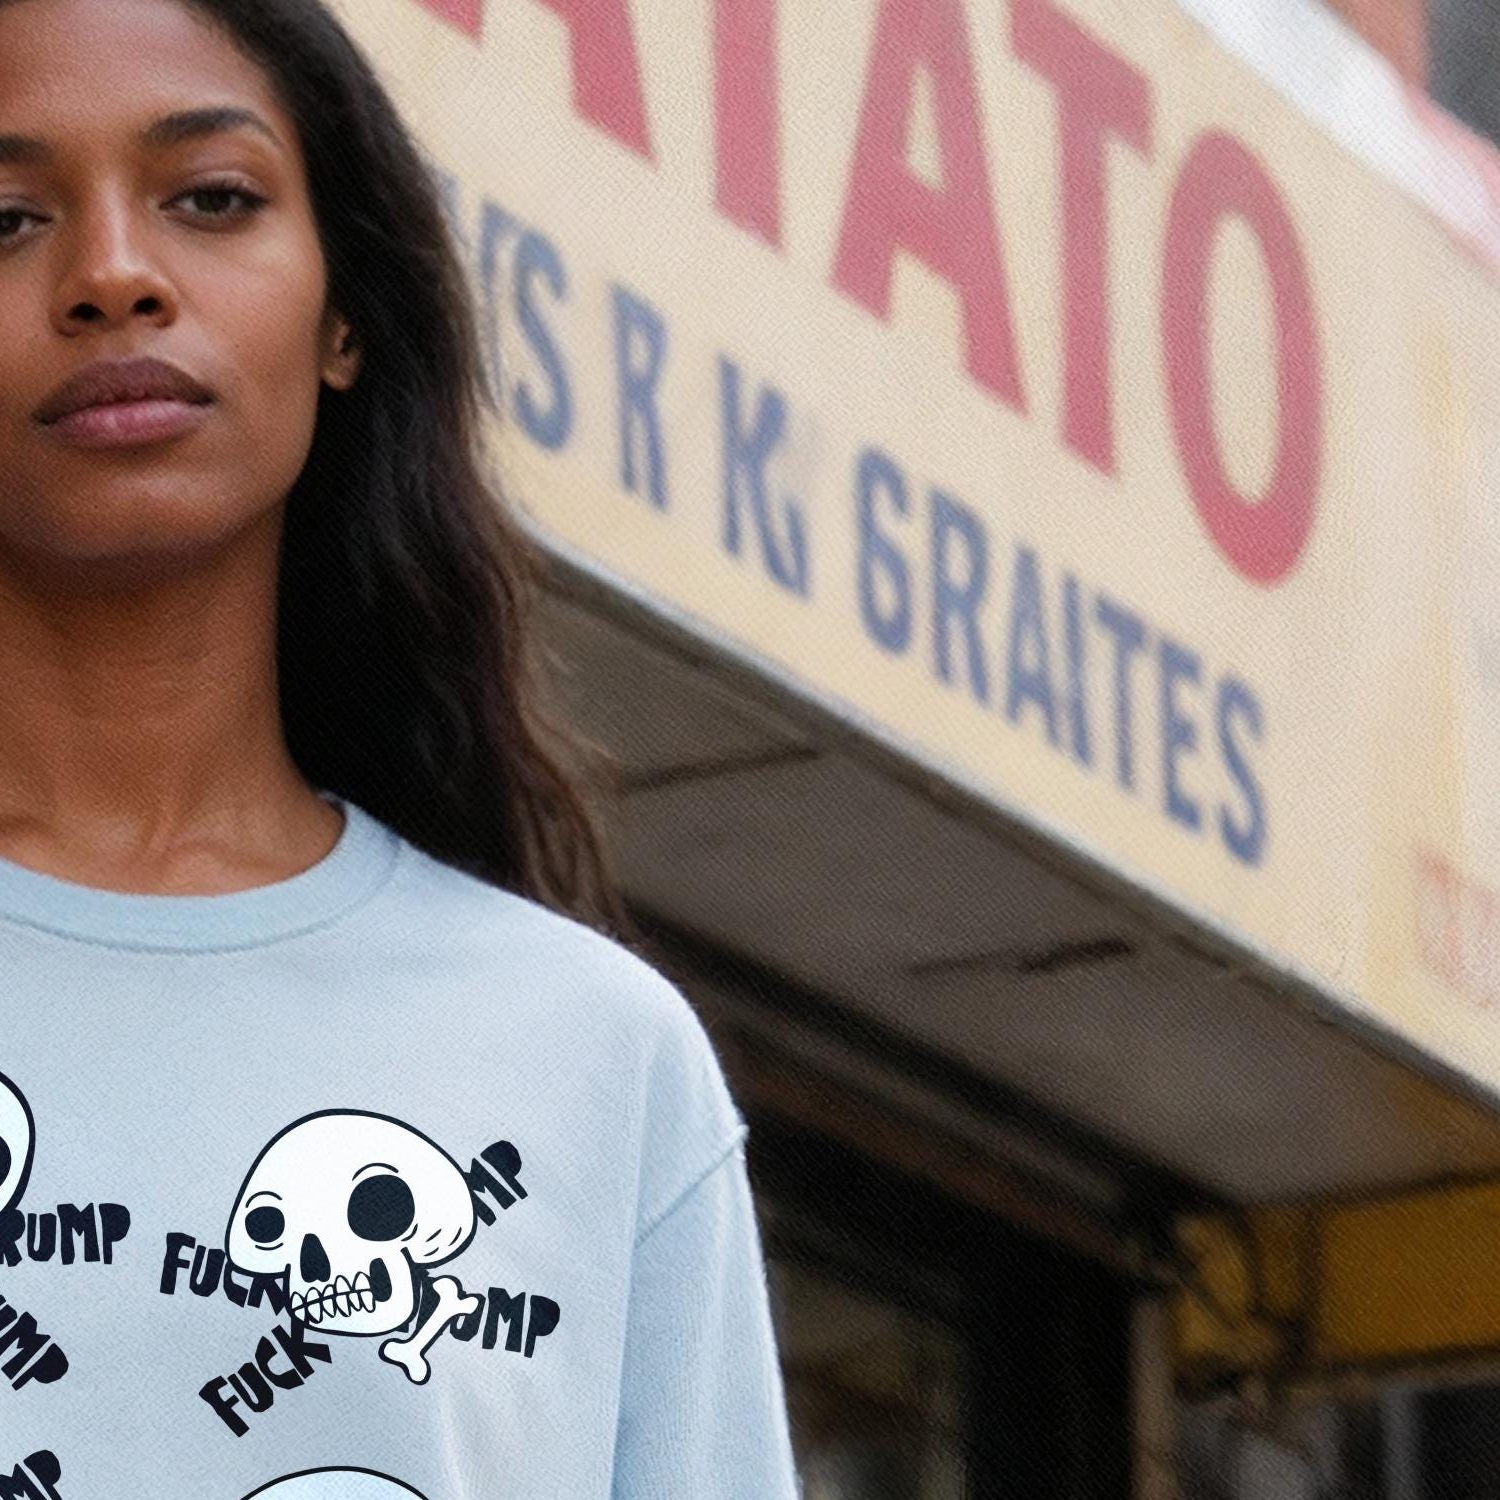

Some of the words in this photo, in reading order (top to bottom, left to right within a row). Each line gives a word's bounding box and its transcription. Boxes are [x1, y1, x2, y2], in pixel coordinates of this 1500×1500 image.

[160, 1232, 288, 1316] FUCK
[402, 1268, 560, 1358] UMP
[199, 1320, 332, 1438] FUCK
